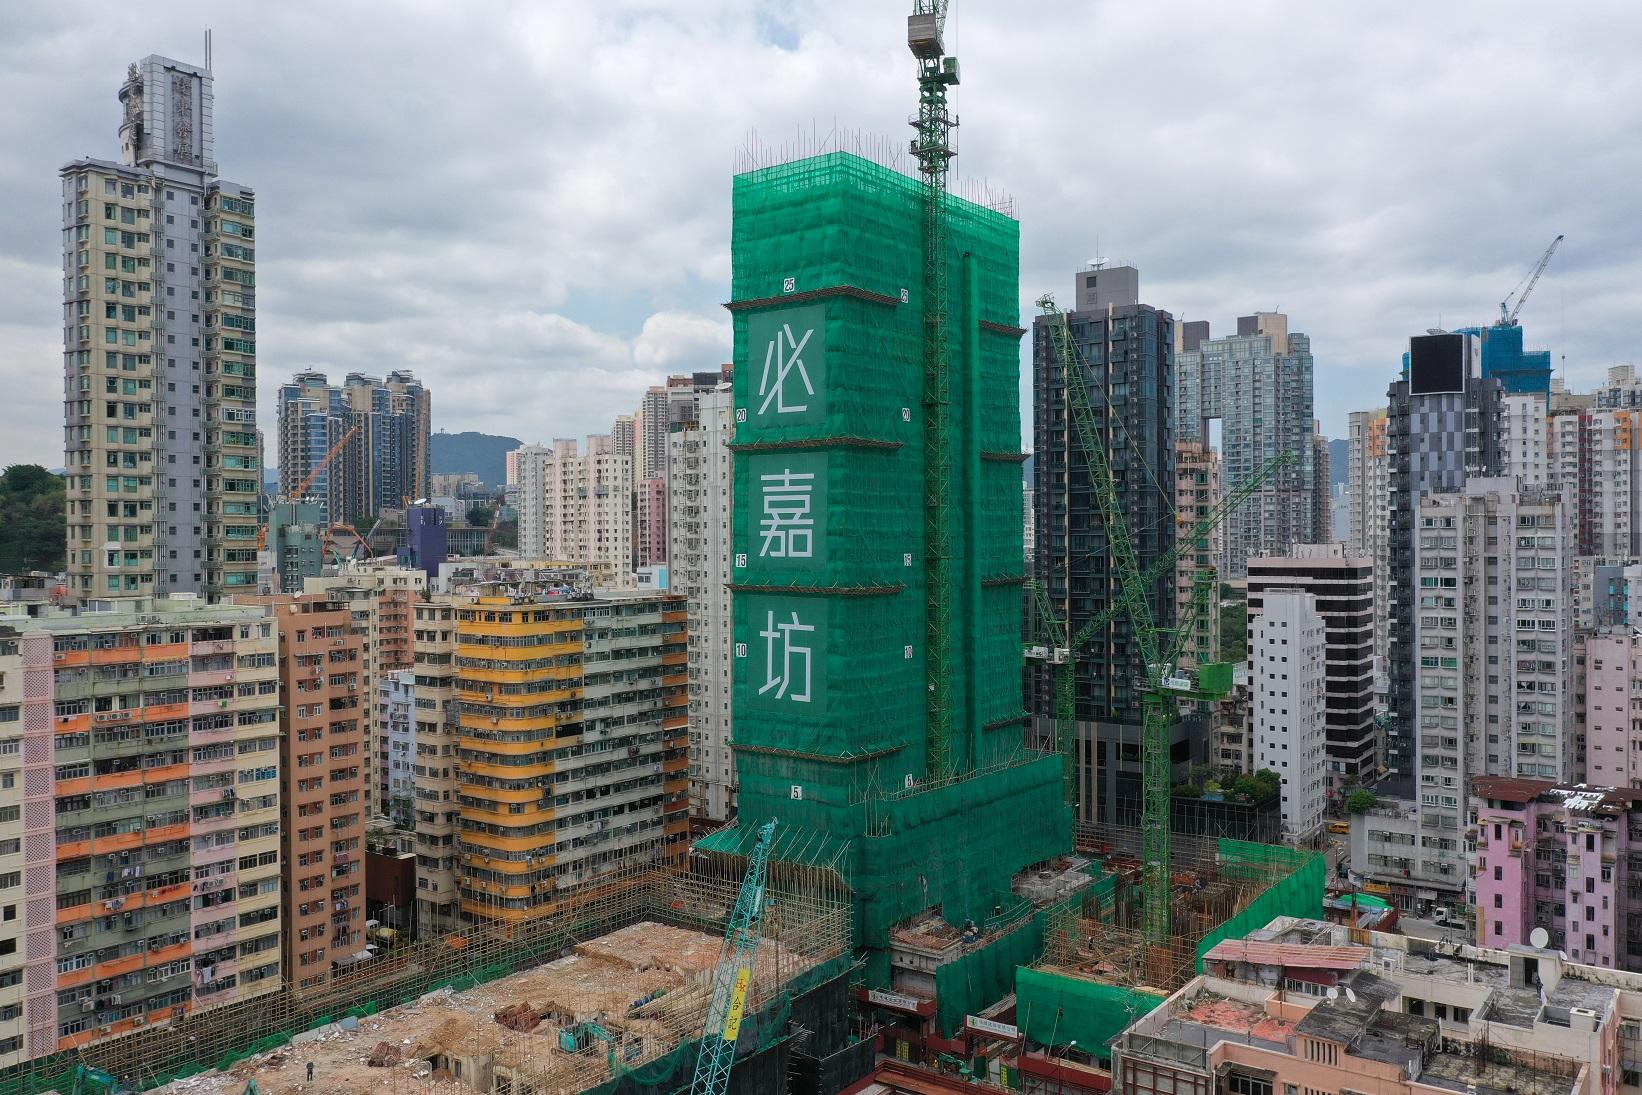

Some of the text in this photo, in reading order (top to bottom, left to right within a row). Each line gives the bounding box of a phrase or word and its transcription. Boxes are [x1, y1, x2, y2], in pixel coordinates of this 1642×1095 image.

[785, 278, 794, 291] 25
[737, 409, 746, 422] 20
[757, 323, 815, 702] 必嘉坊
[736, 554, 746, 567] 15
[736, 645, 746, 657] 10
[907, 775, 912, 786] 5
[793, 787, 800, 799] 5
